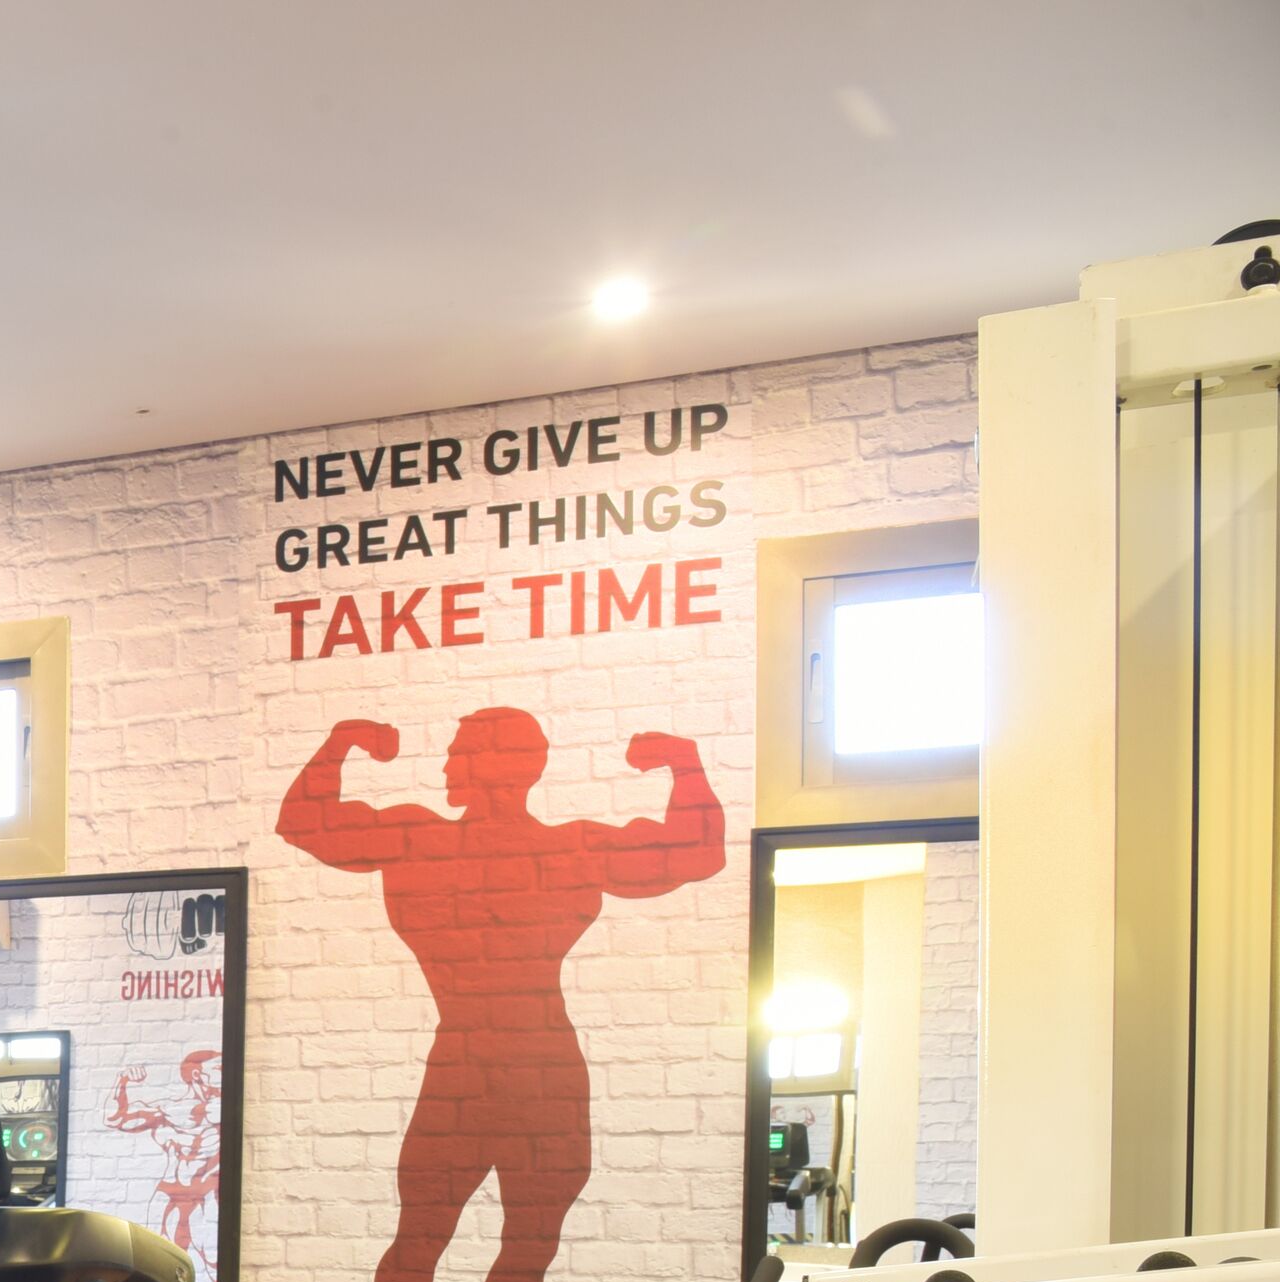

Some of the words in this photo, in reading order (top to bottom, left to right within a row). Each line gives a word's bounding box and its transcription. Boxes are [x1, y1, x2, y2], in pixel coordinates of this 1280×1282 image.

[274, 437, 463, 503] NEVER
[483, 416, 621, 476] GIVE
[643, 403, 729, 458] UP
[275, 508, 467, 574] GREAT
[486, 479, 727, 550] THINGS
[274, 582, 485, 662] TAKE
[511, 556, 722, 639] TIME
